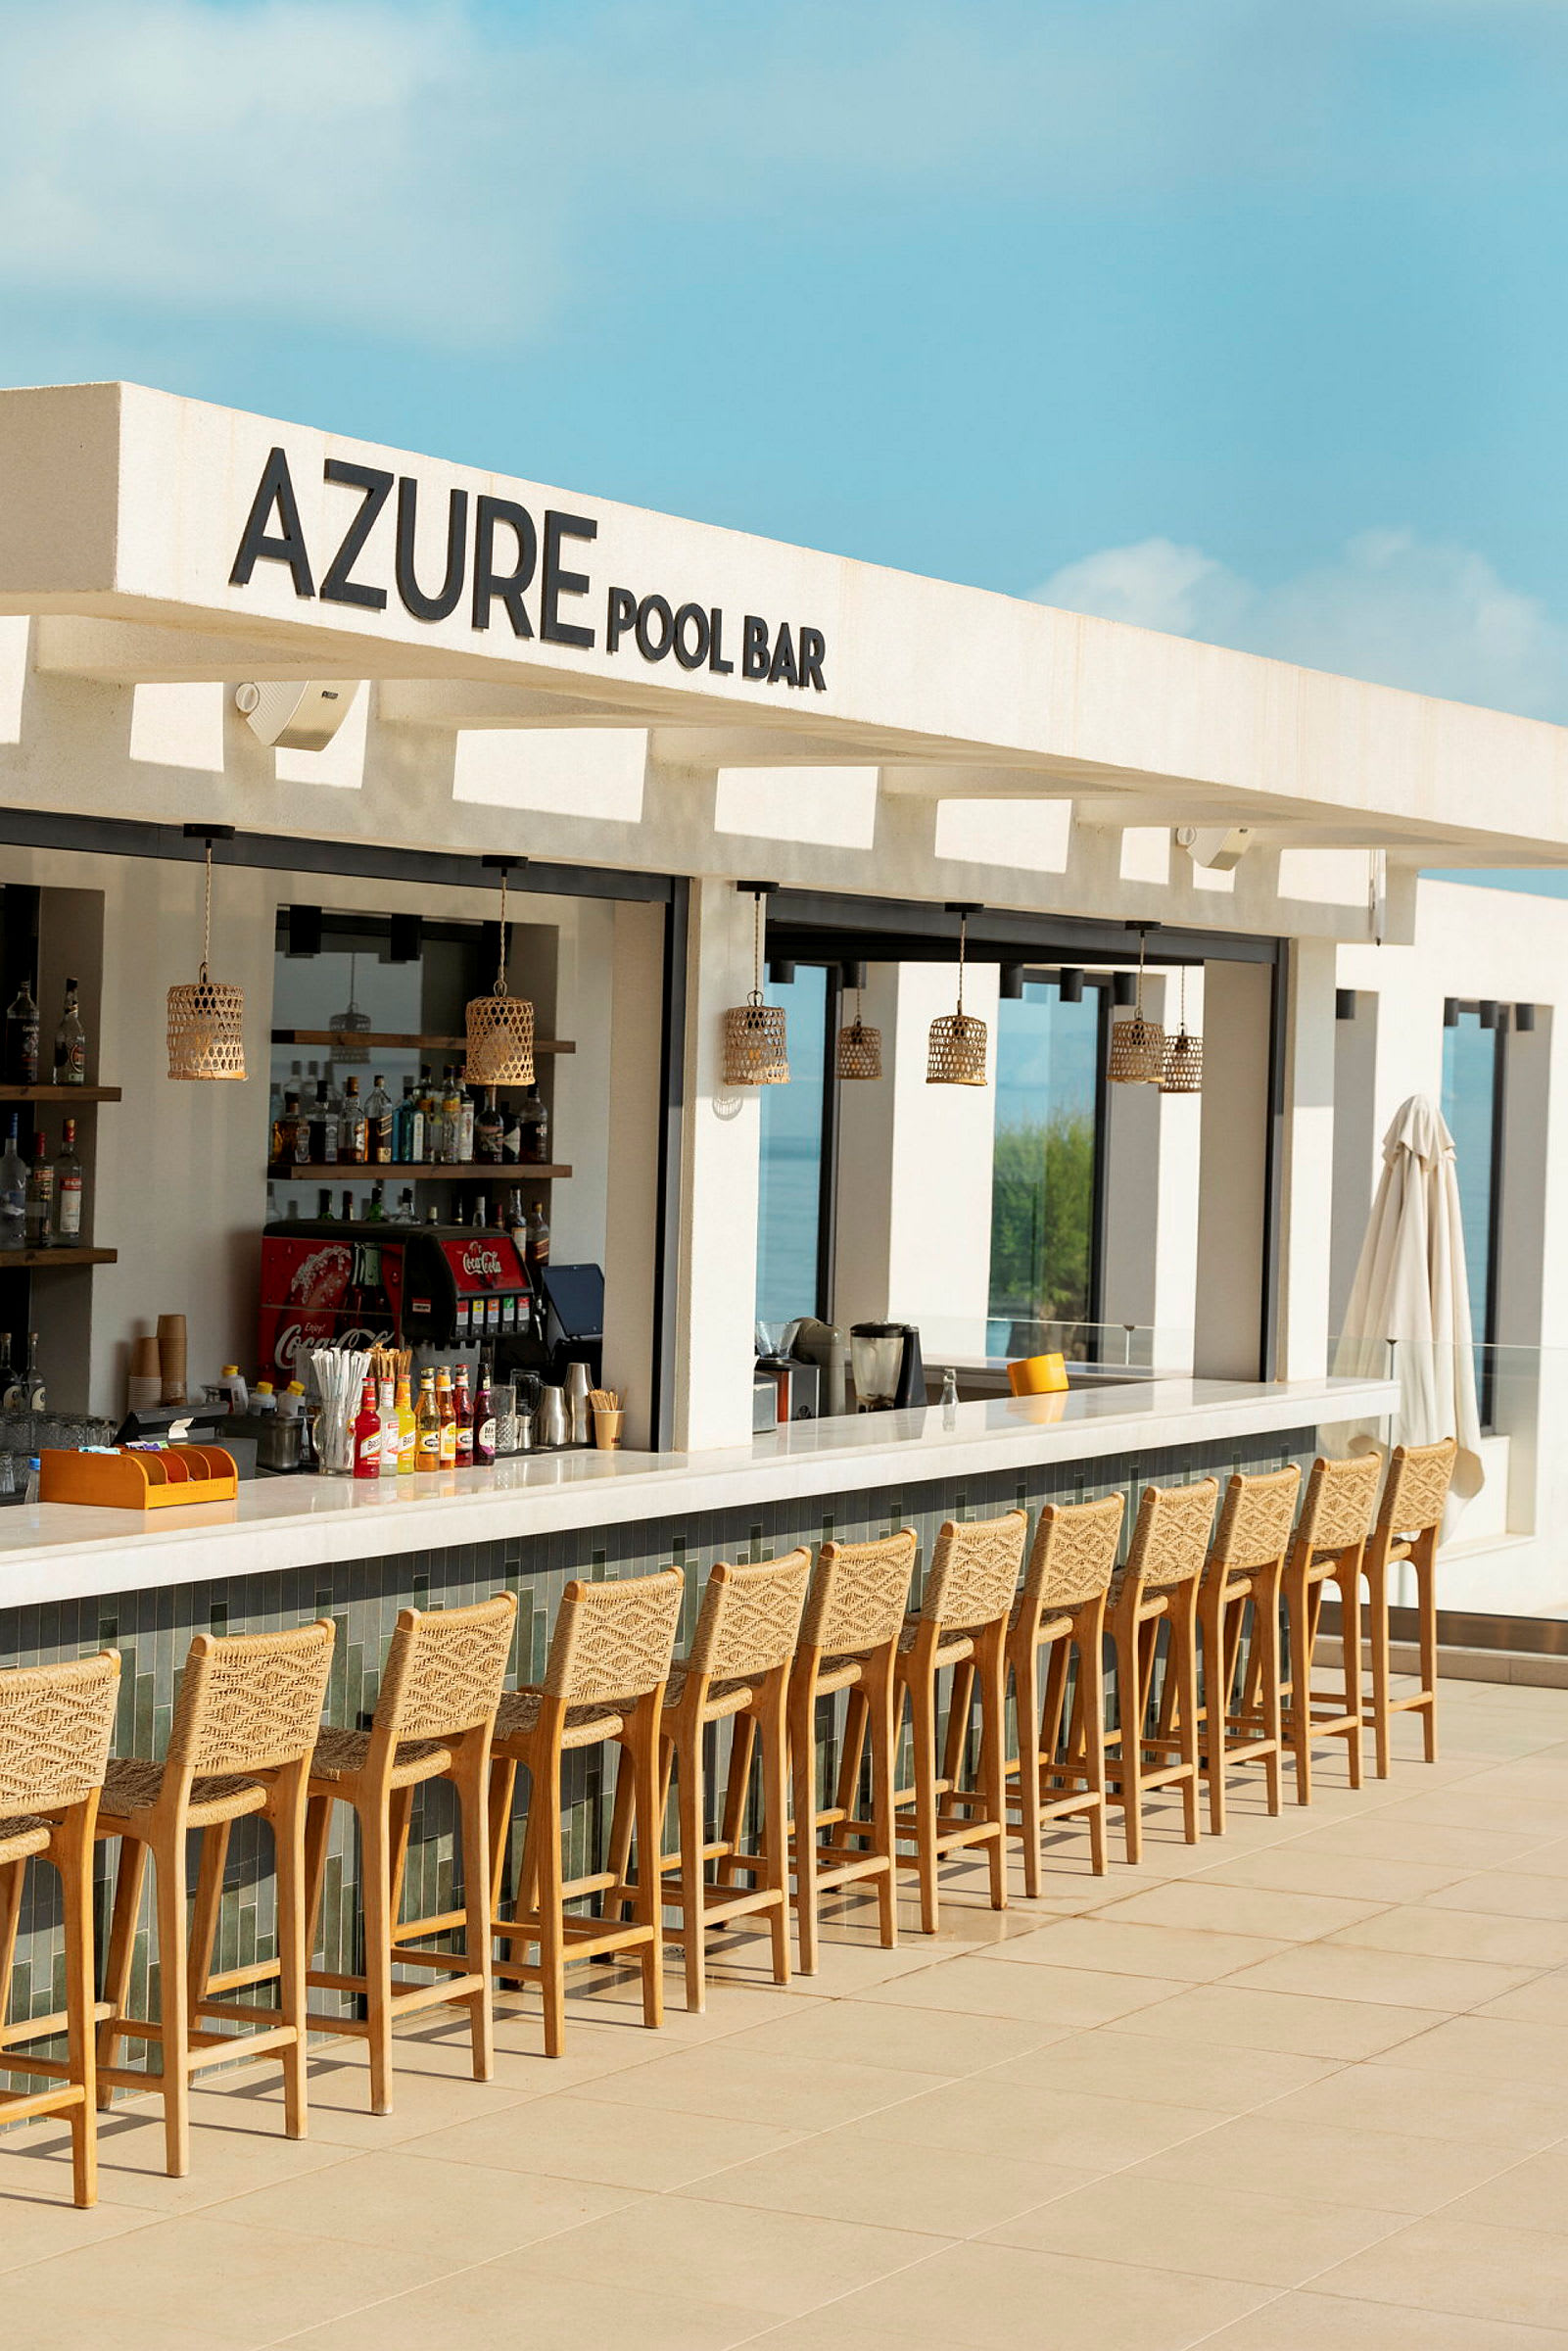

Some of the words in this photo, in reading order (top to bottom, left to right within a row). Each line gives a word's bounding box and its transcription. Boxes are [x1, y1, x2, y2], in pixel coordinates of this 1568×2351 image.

[229, 447, 596, 648] AZURE
[606, 586, 734, 674] POOL
[742, 615, 827, 691] BAR
[462, 1249, 502, 1275] Coca-Cola
